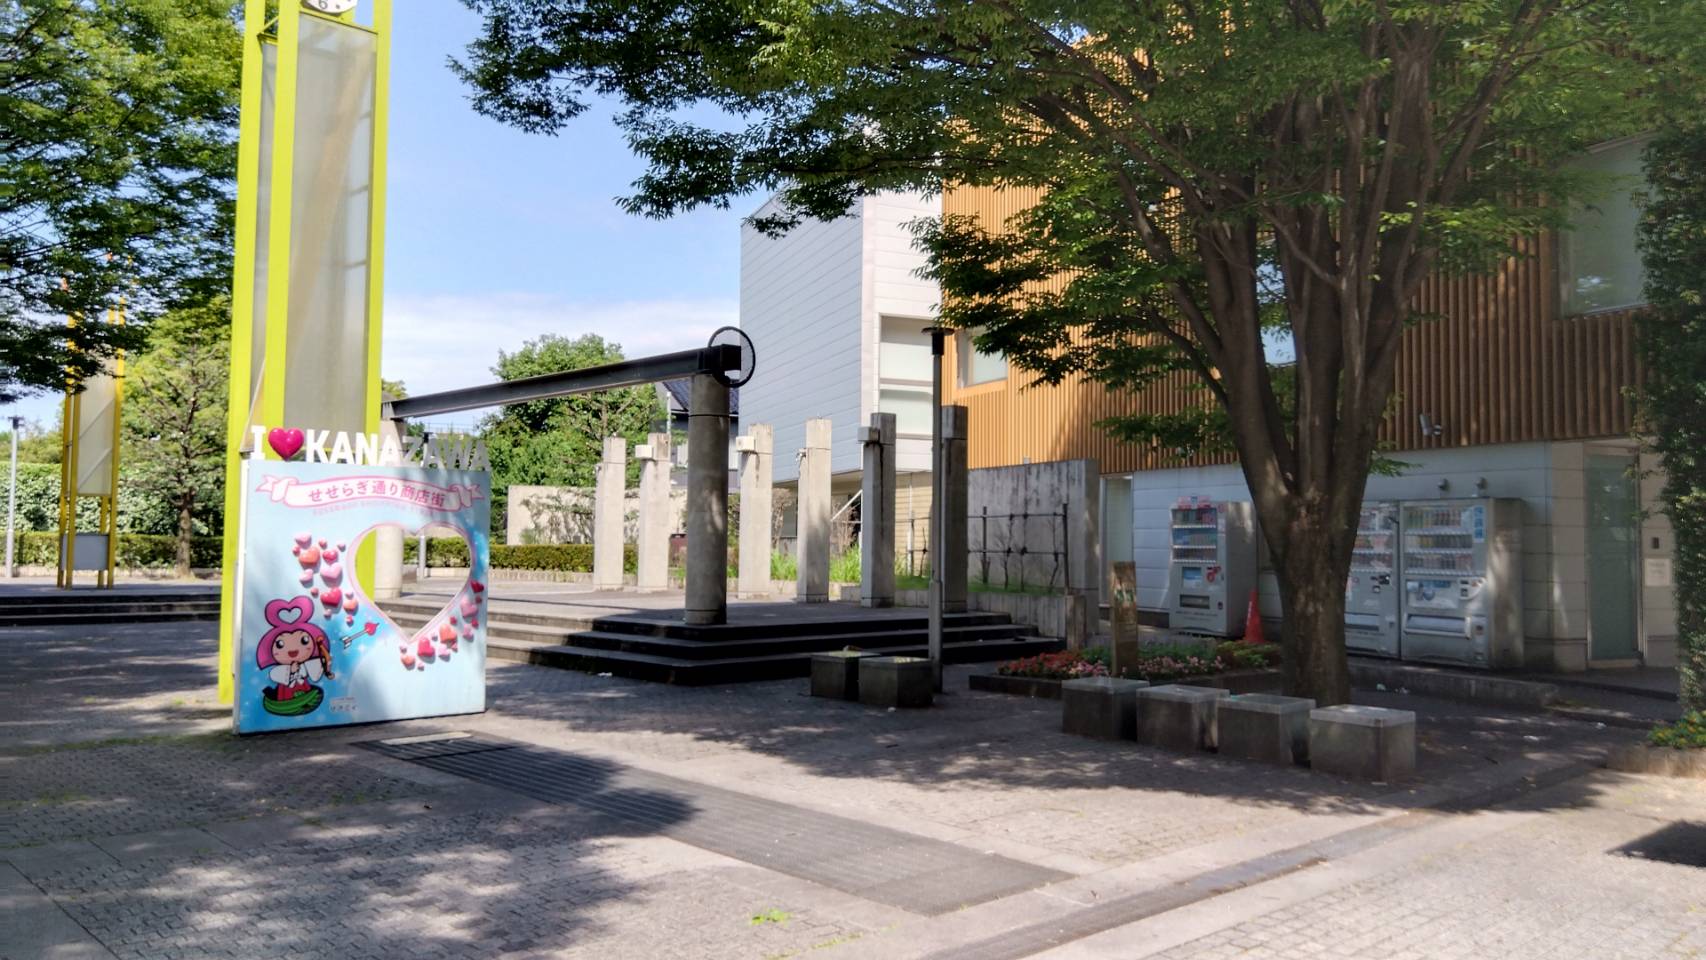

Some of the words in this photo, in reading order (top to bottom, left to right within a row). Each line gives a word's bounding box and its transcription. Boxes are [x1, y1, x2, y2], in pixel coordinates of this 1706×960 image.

[319, 0, 328, 9] 6
[250, 425, 266, 460] I
[305, 429, 492, 472] KANAZAWA
[309, 480, 446, 507] せせらぎ通り商店街
